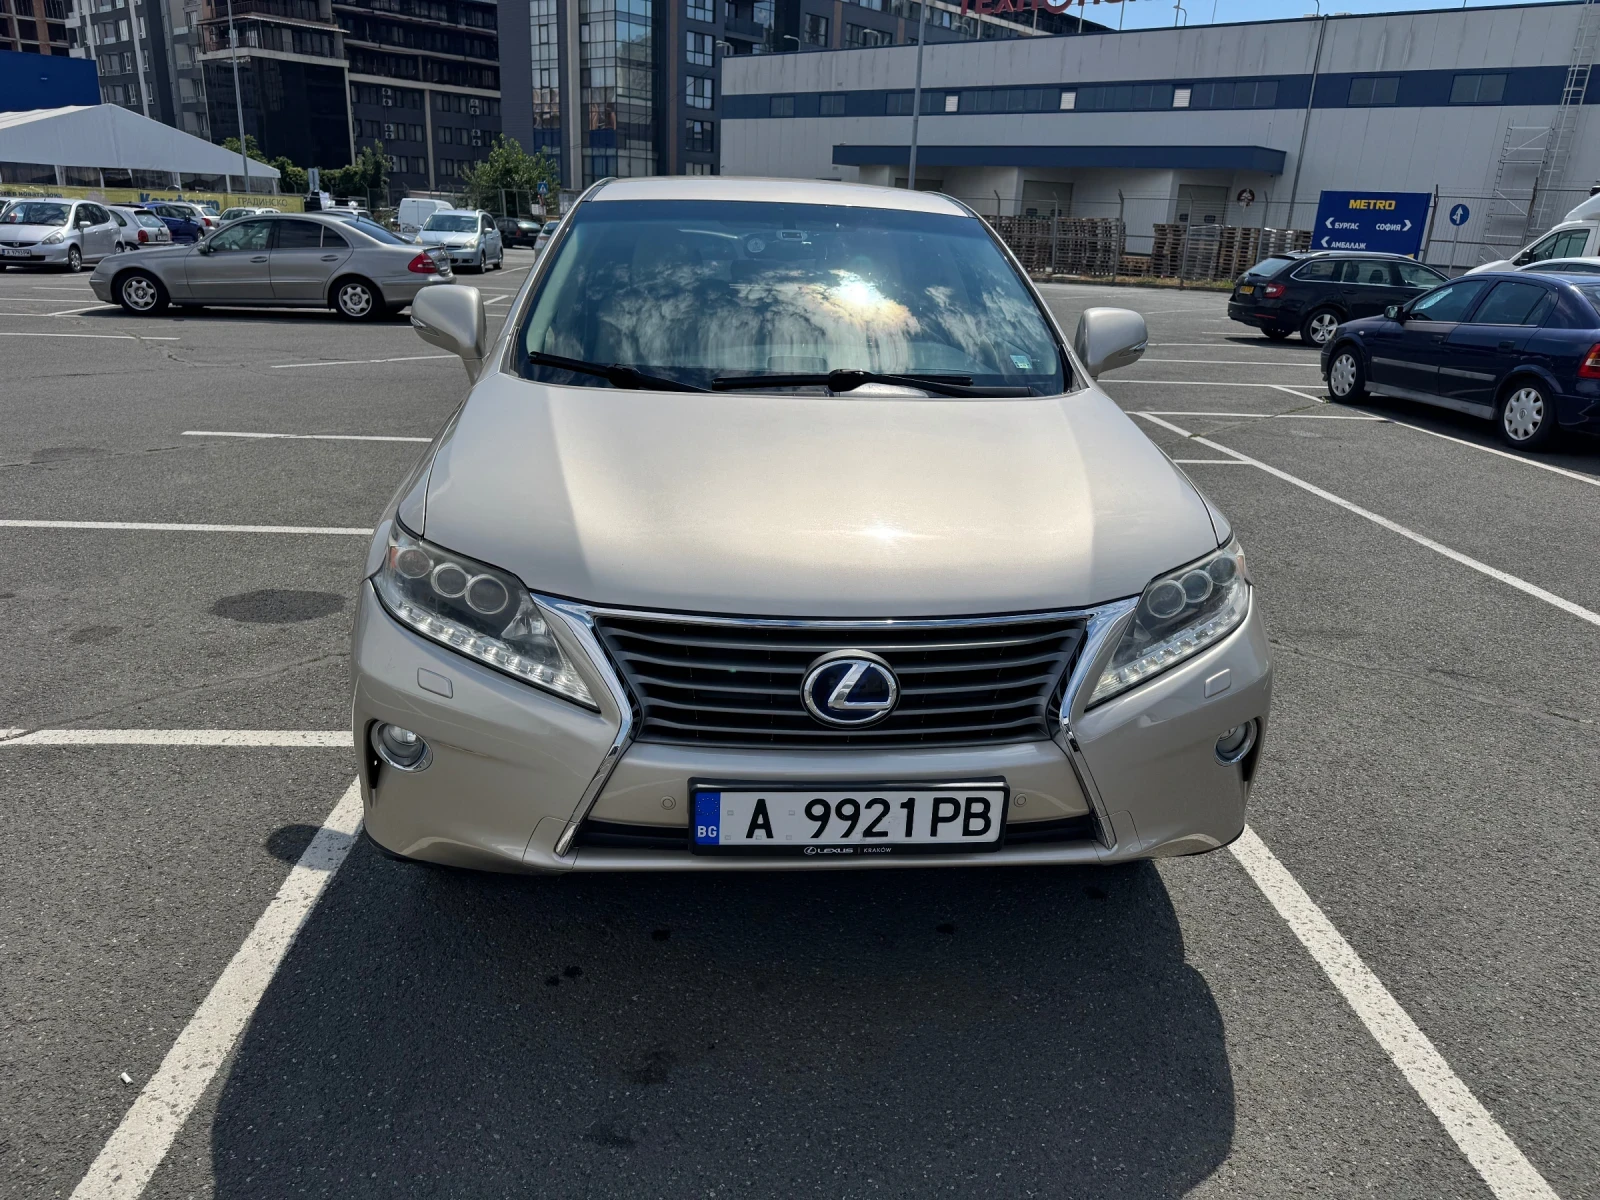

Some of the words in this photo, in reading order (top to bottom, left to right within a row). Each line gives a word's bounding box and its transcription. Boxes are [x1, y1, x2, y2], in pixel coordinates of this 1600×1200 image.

[237, 197, 288, 207] ГРАДИНСКО
[1348, 199, 1396, 210] METRO
[1334, 222, 1360, 230] БУРГАС
[1375, 223, 1401, 231] СОФИЯ
[1330, 241, 1367, 250] АМБАЛАЖ
[697, 825, 717, 838] BG
